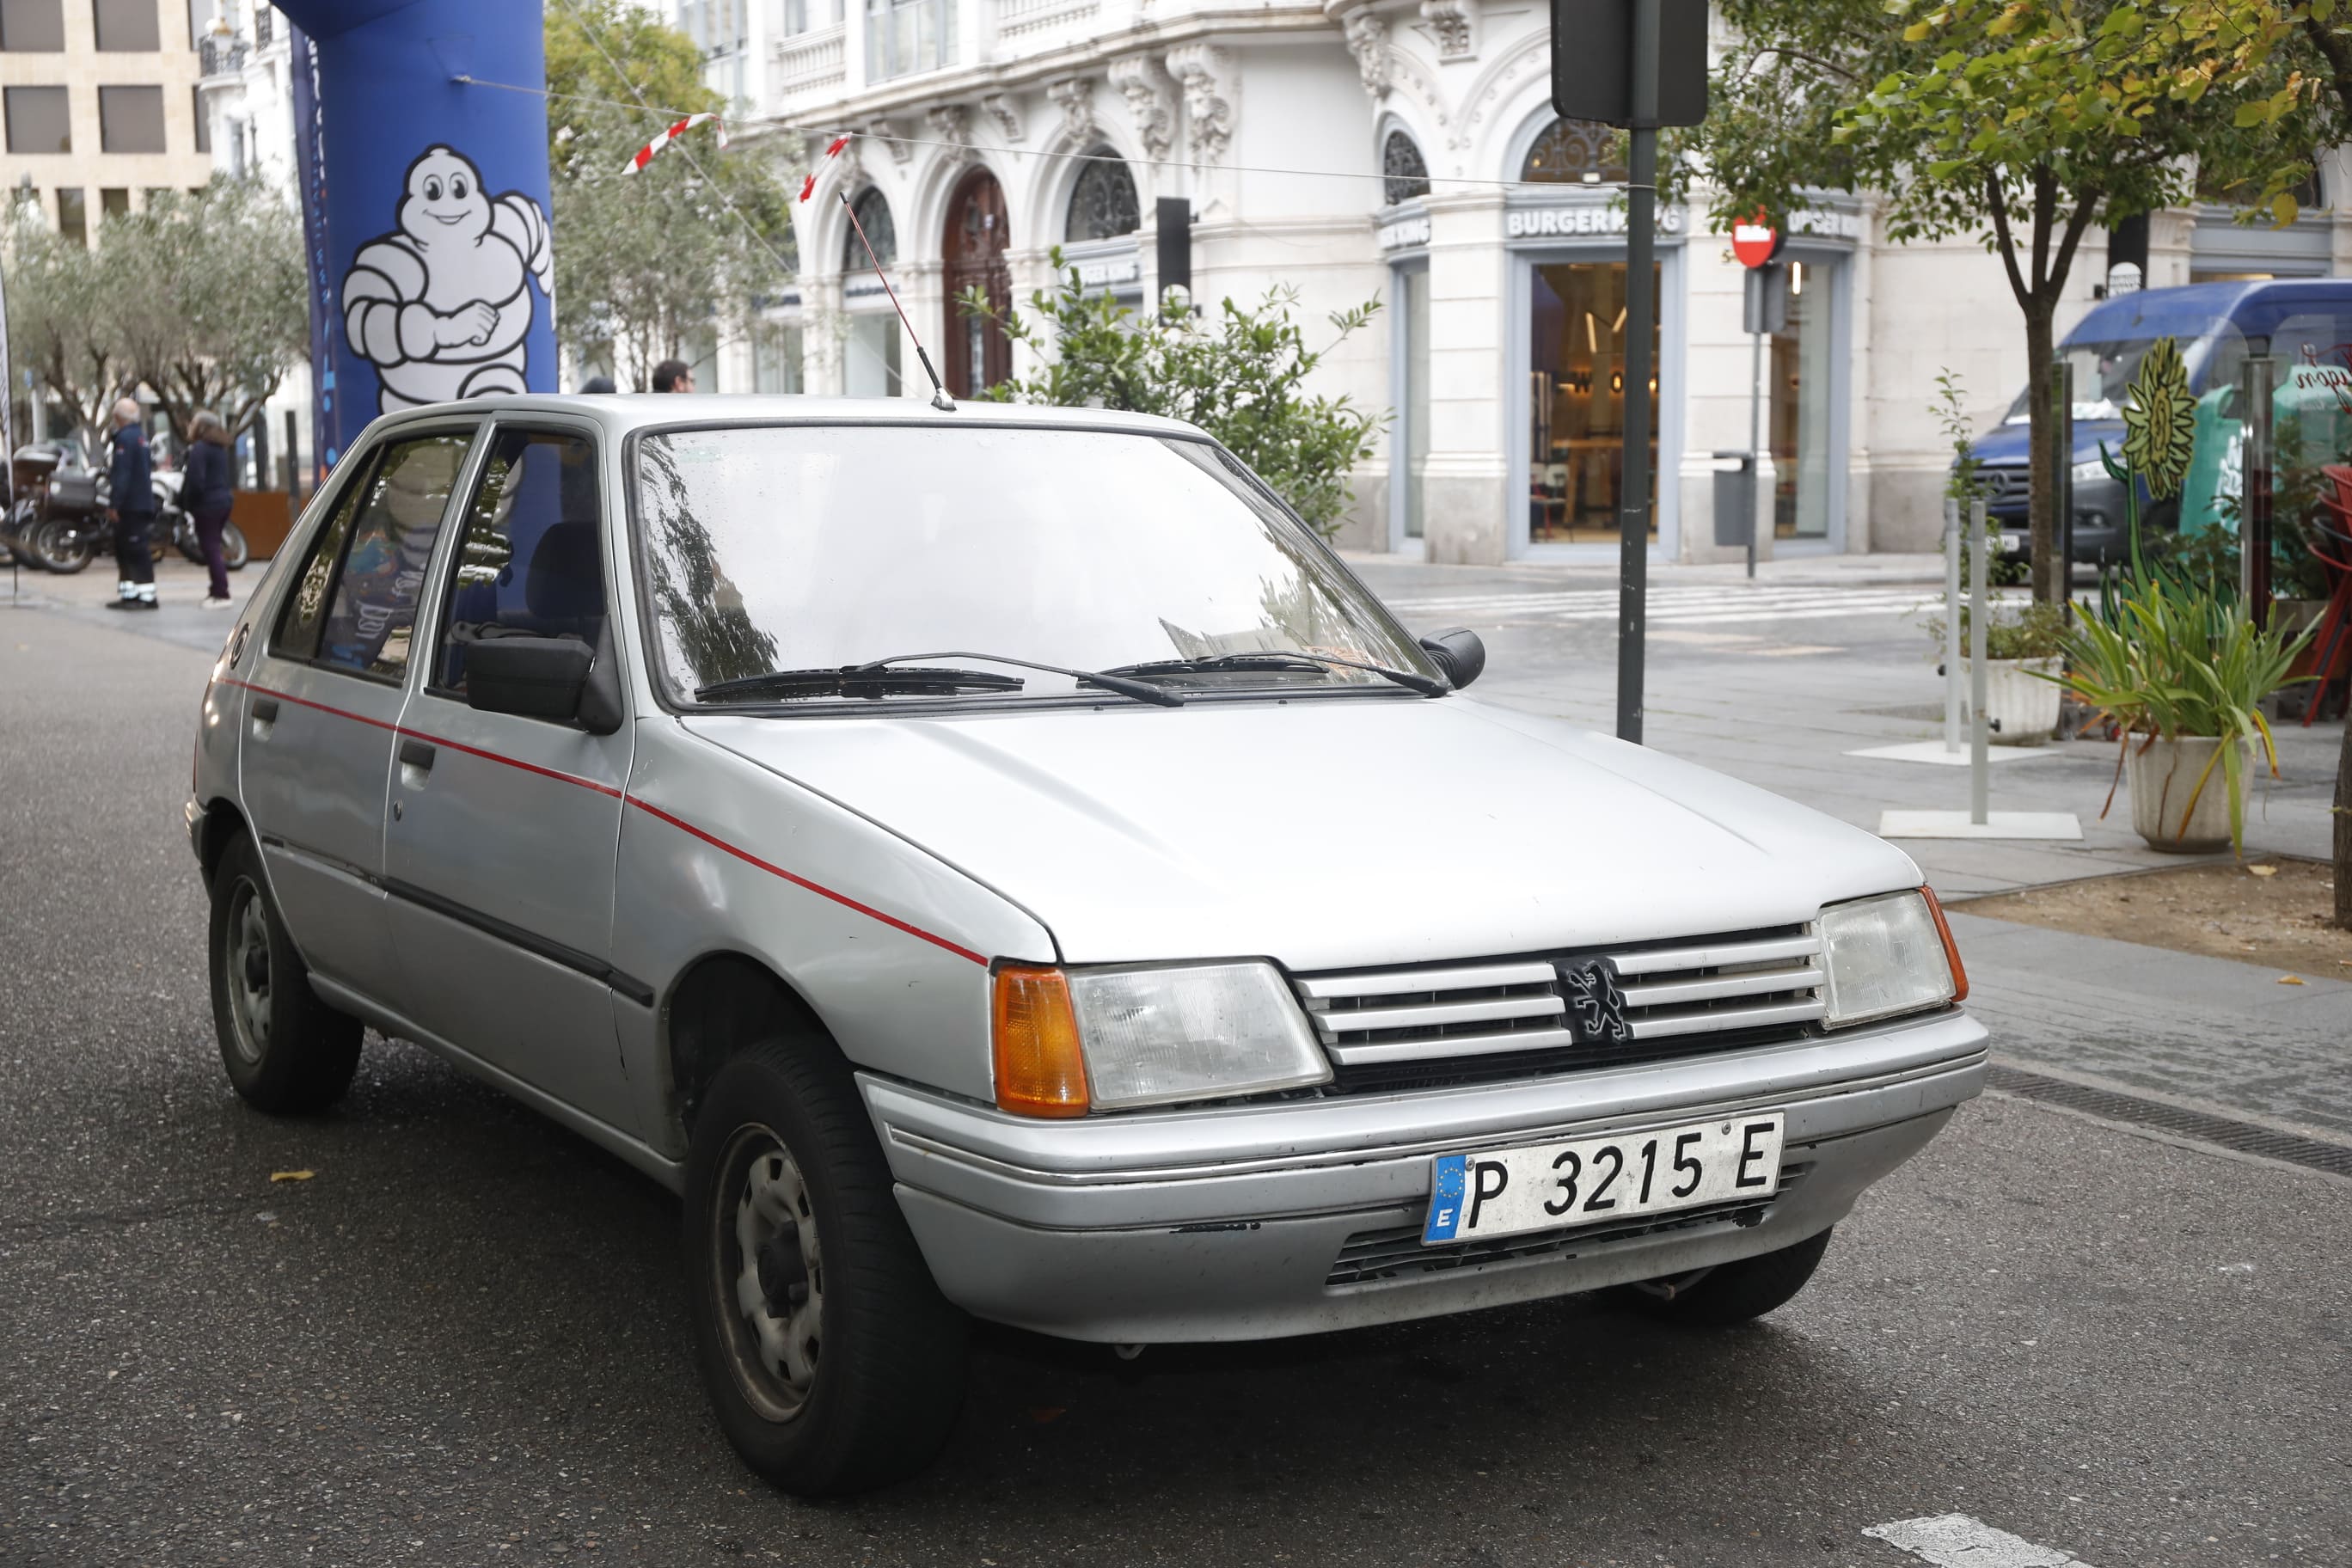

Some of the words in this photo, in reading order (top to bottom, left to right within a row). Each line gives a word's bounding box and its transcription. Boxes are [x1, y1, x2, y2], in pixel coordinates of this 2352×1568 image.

[1508, 210, 1608, 236] BURGER
[1467, 1161, 1510, 1229] P
[1543, 1131, 1702, 1216] 3215
[1736, 1122, 1775, 1189] E
[1436, 1208, 1453, 1228] E
